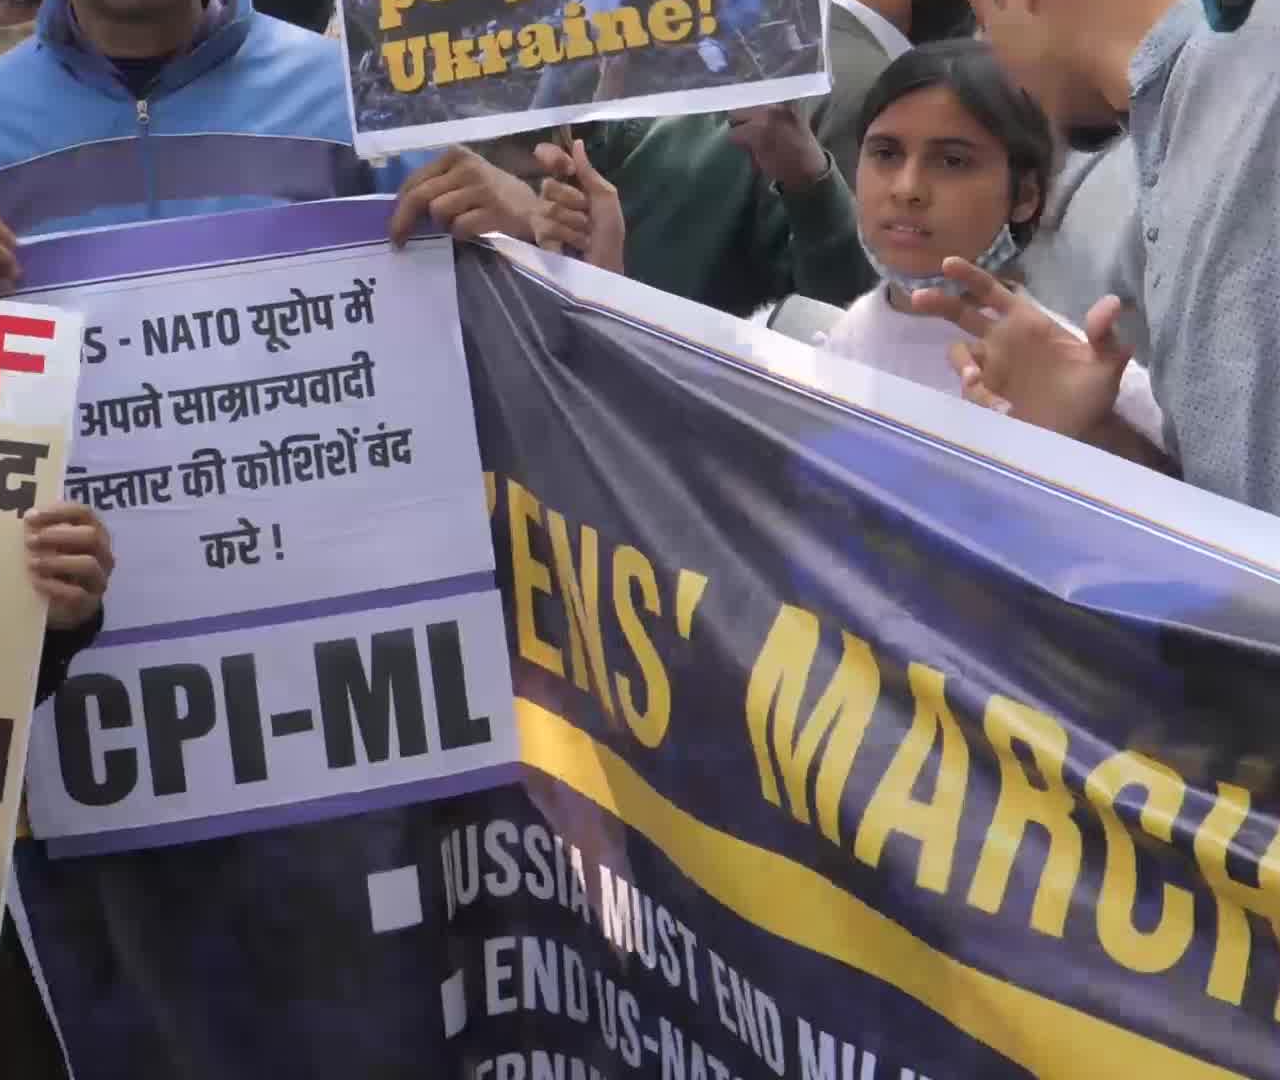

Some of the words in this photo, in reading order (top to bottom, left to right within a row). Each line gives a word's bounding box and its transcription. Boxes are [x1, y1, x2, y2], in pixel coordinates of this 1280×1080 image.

[80, 326, 107, 364] S
[142, 306, 241, 357] NATO
[246, 288, 335, 354] यूरोप
[341, 277, 377, 326] में
[80, 382, 162, 437] अपने
[177, 447, 227, 499] की
[232, 425, 360, 492] कोशिशें
[362, 421, 413, 469] बंद
[484, 472, 708, 749] ENS'
[54, 620, 492, 807] CPI-ML
[484, 935, 589, 1023] END
[598, 863, 699, 1003] MUST
[709, 947, 785, 1077] END
